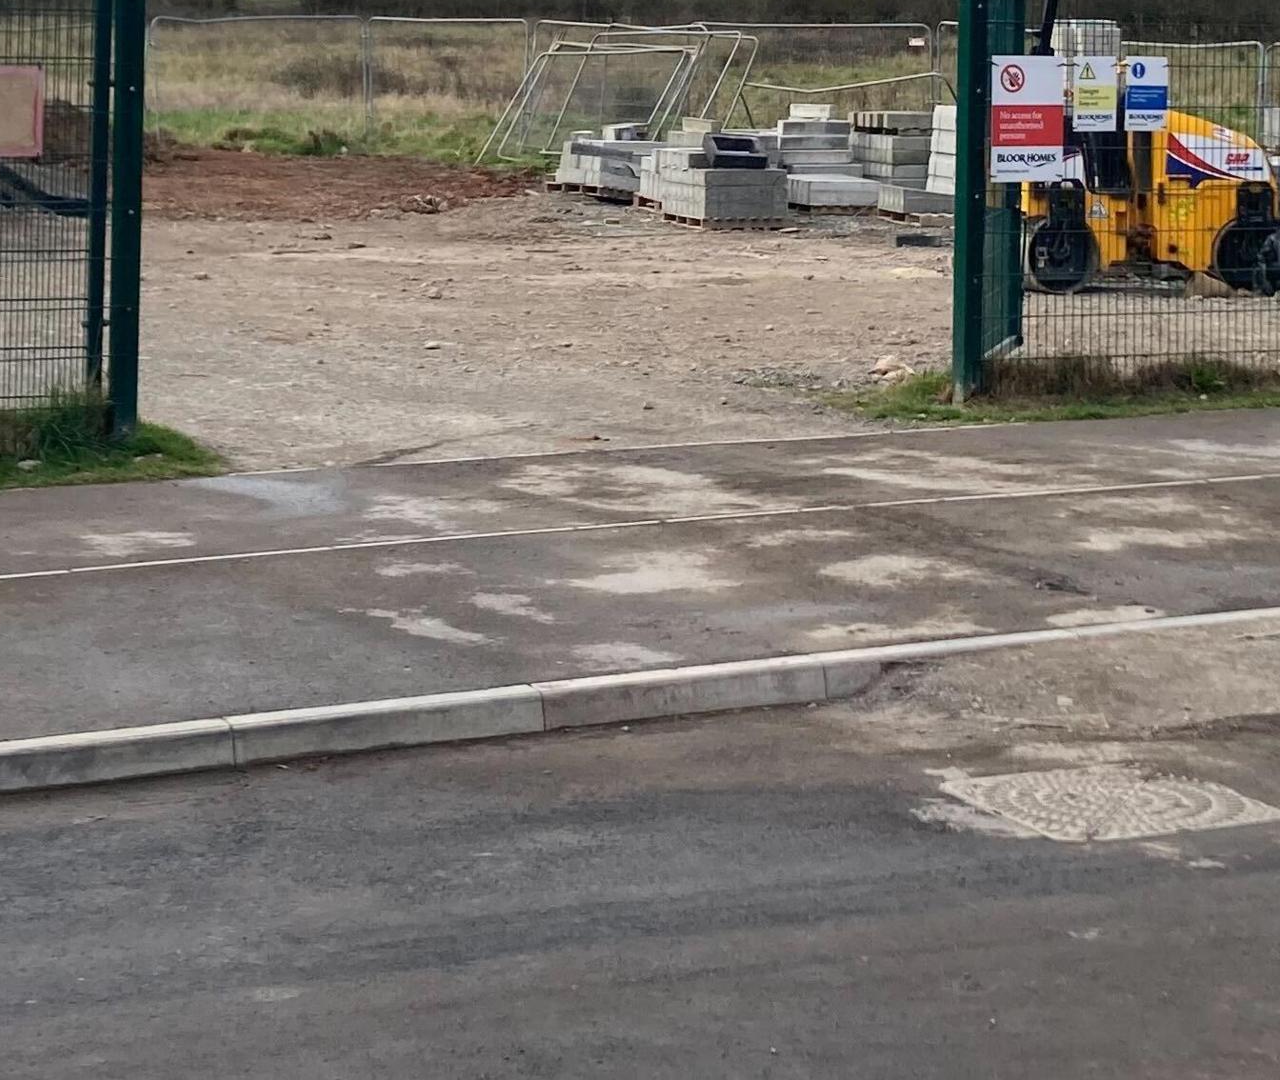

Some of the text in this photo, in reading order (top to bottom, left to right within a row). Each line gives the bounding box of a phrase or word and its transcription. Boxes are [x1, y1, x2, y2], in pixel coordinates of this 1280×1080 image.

[999, 110, 1010, 119] No
[1032, 110, 1043, 119] for
[996, 153, 1057, 164] BLOOR HOMES
